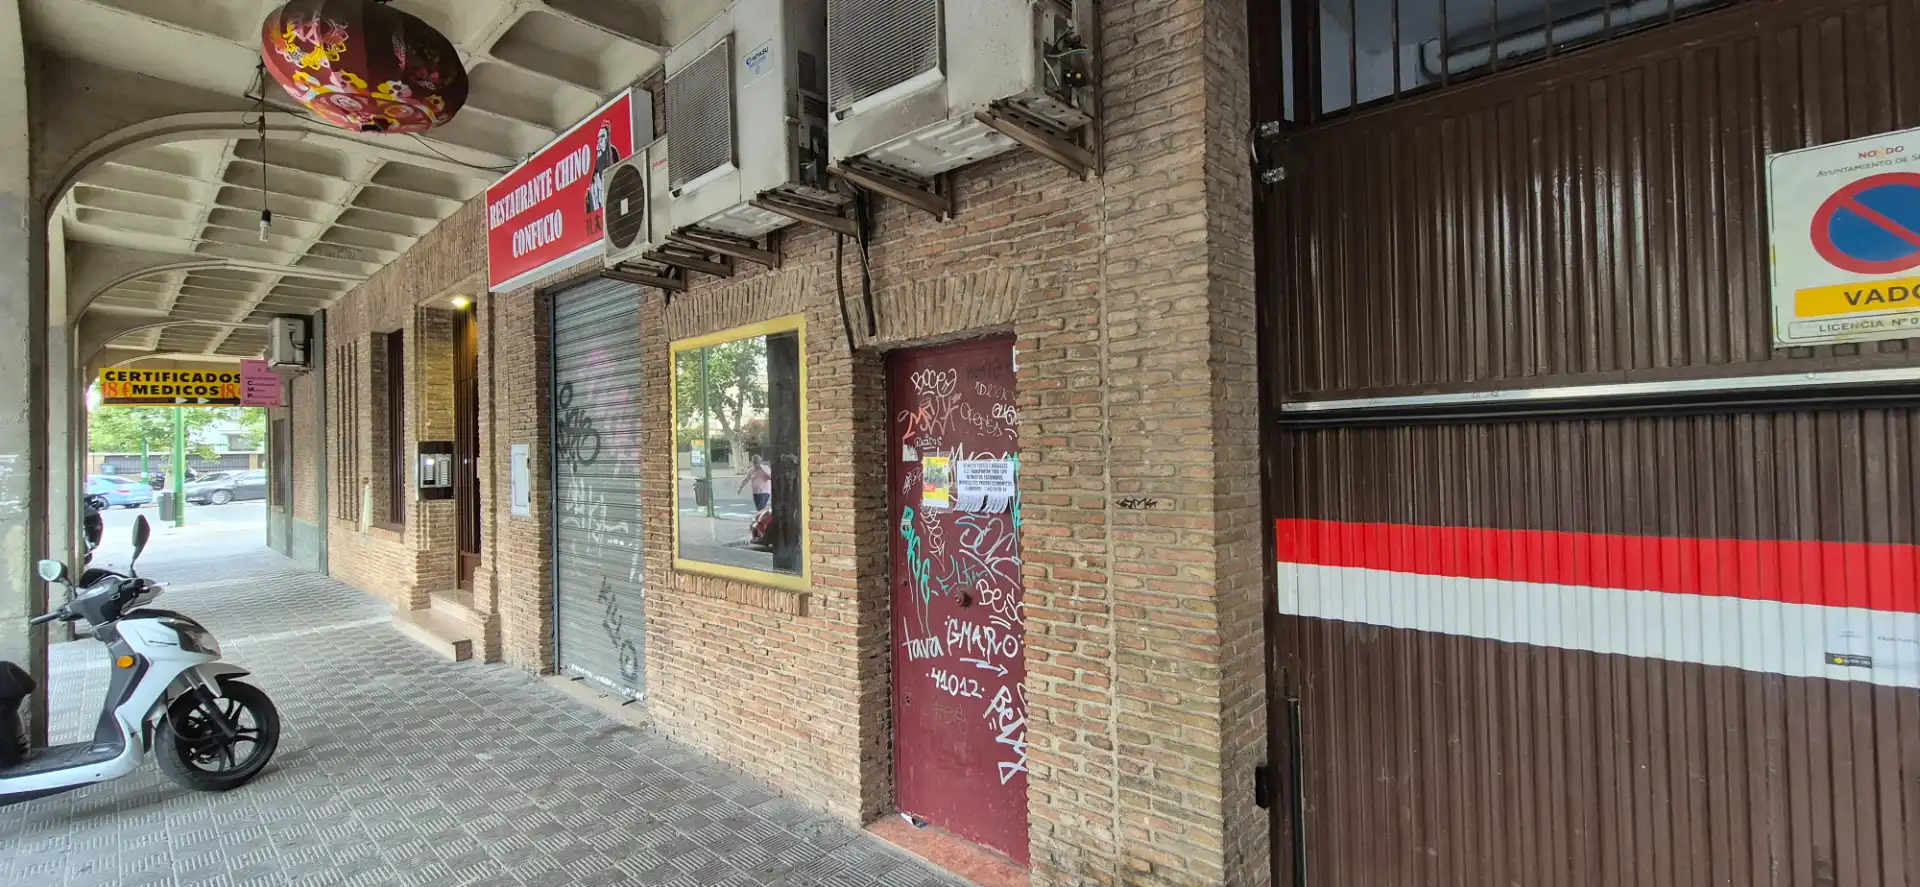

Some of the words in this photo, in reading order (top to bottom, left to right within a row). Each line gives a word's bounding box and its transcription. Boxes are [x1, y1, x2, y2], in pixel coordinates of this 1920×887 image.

[1817, 159, 1892, 177] AYUNTAMIENTO
[1895, 156, 1908, 164] DE
[490, 168, 552, 230] RESTAURANTE
[554, 144, 591, 191] CHINO
[512, 209, 563, 258] CONFUCIO
[1819, 320, 1884, 332] LICENCIA
[132, 384, 219, 395] MEDICOS
